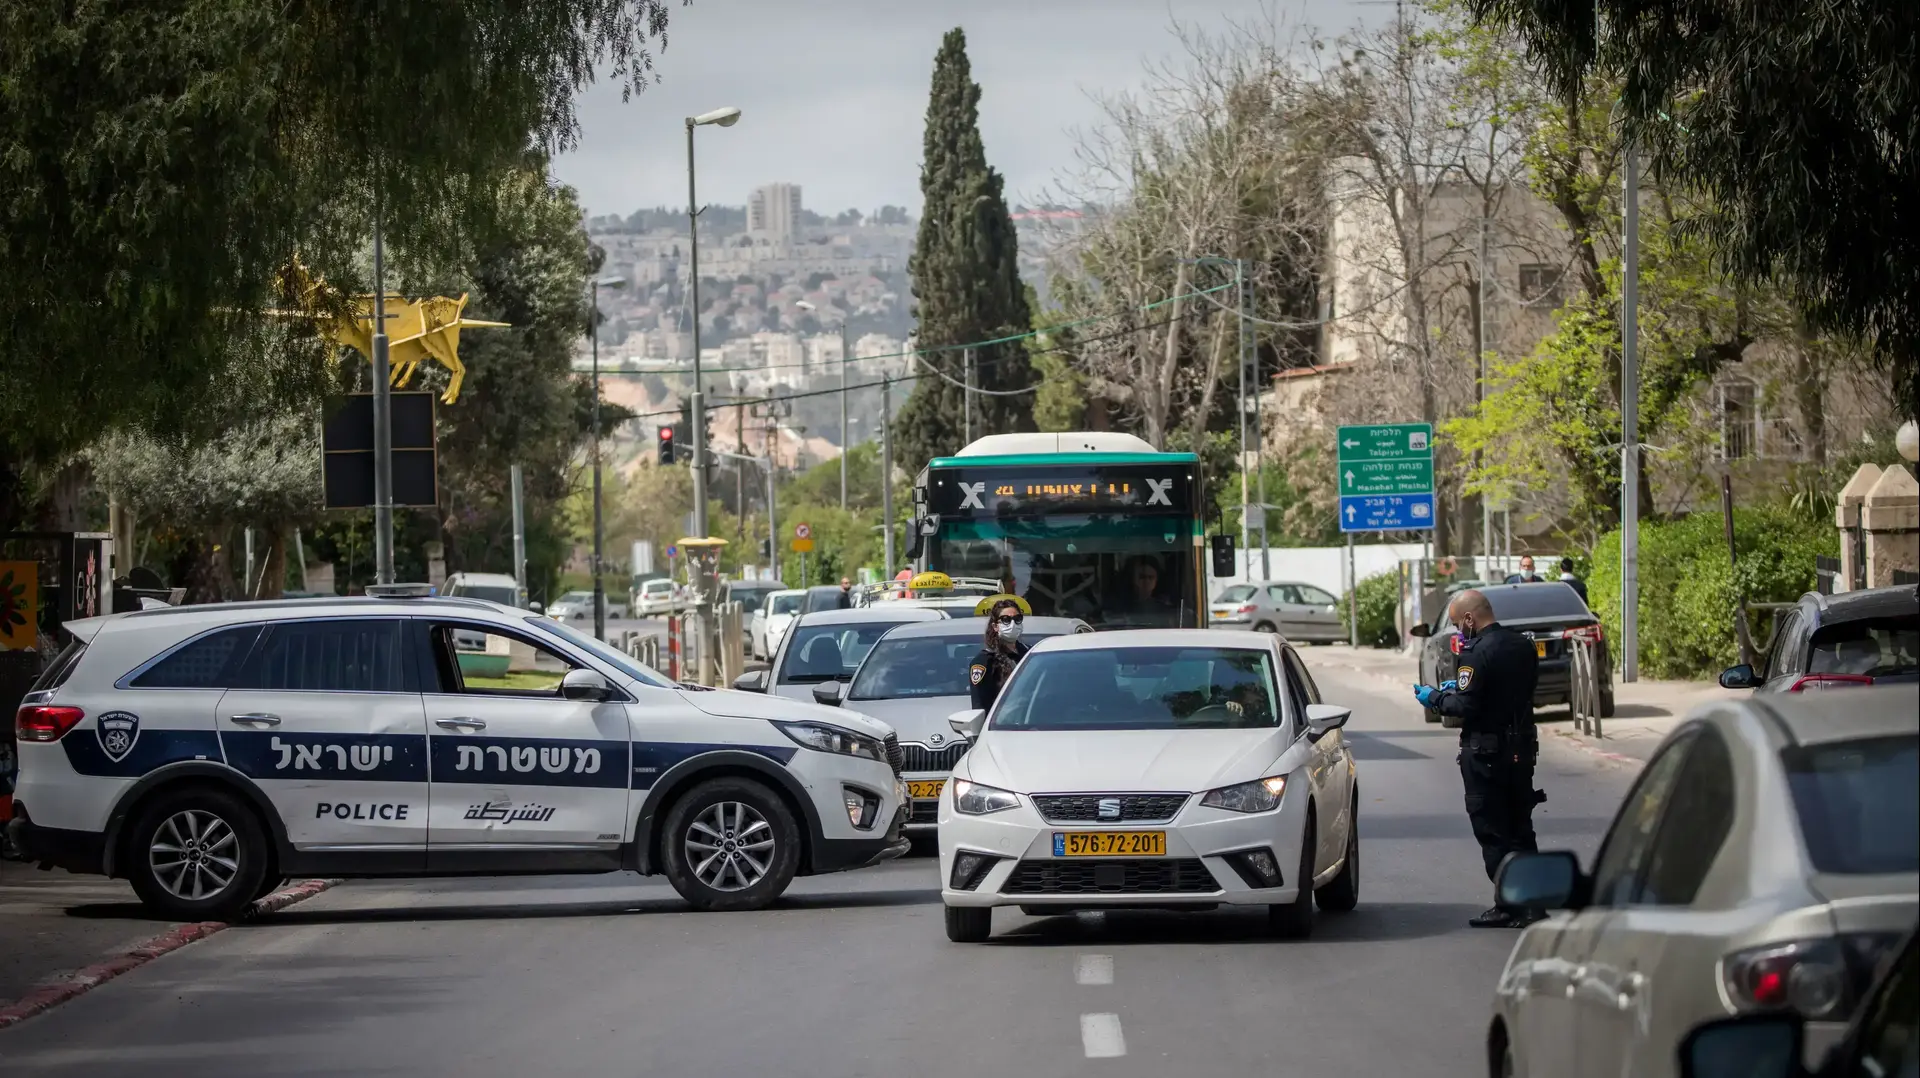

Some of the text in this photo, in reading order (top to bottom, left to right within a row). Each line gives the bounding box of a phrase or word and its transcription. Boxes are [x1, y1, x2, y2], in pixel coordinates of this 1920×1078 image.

[1370, 428, 1401, 437] תלפיות
[1369, 449, 1403, 457] Talpiyot
[271, 736, 601, 774] משטרת ישראל
[316, 803, 409, 820] POLICE
[463, 802, 556, 825] الشرطة
